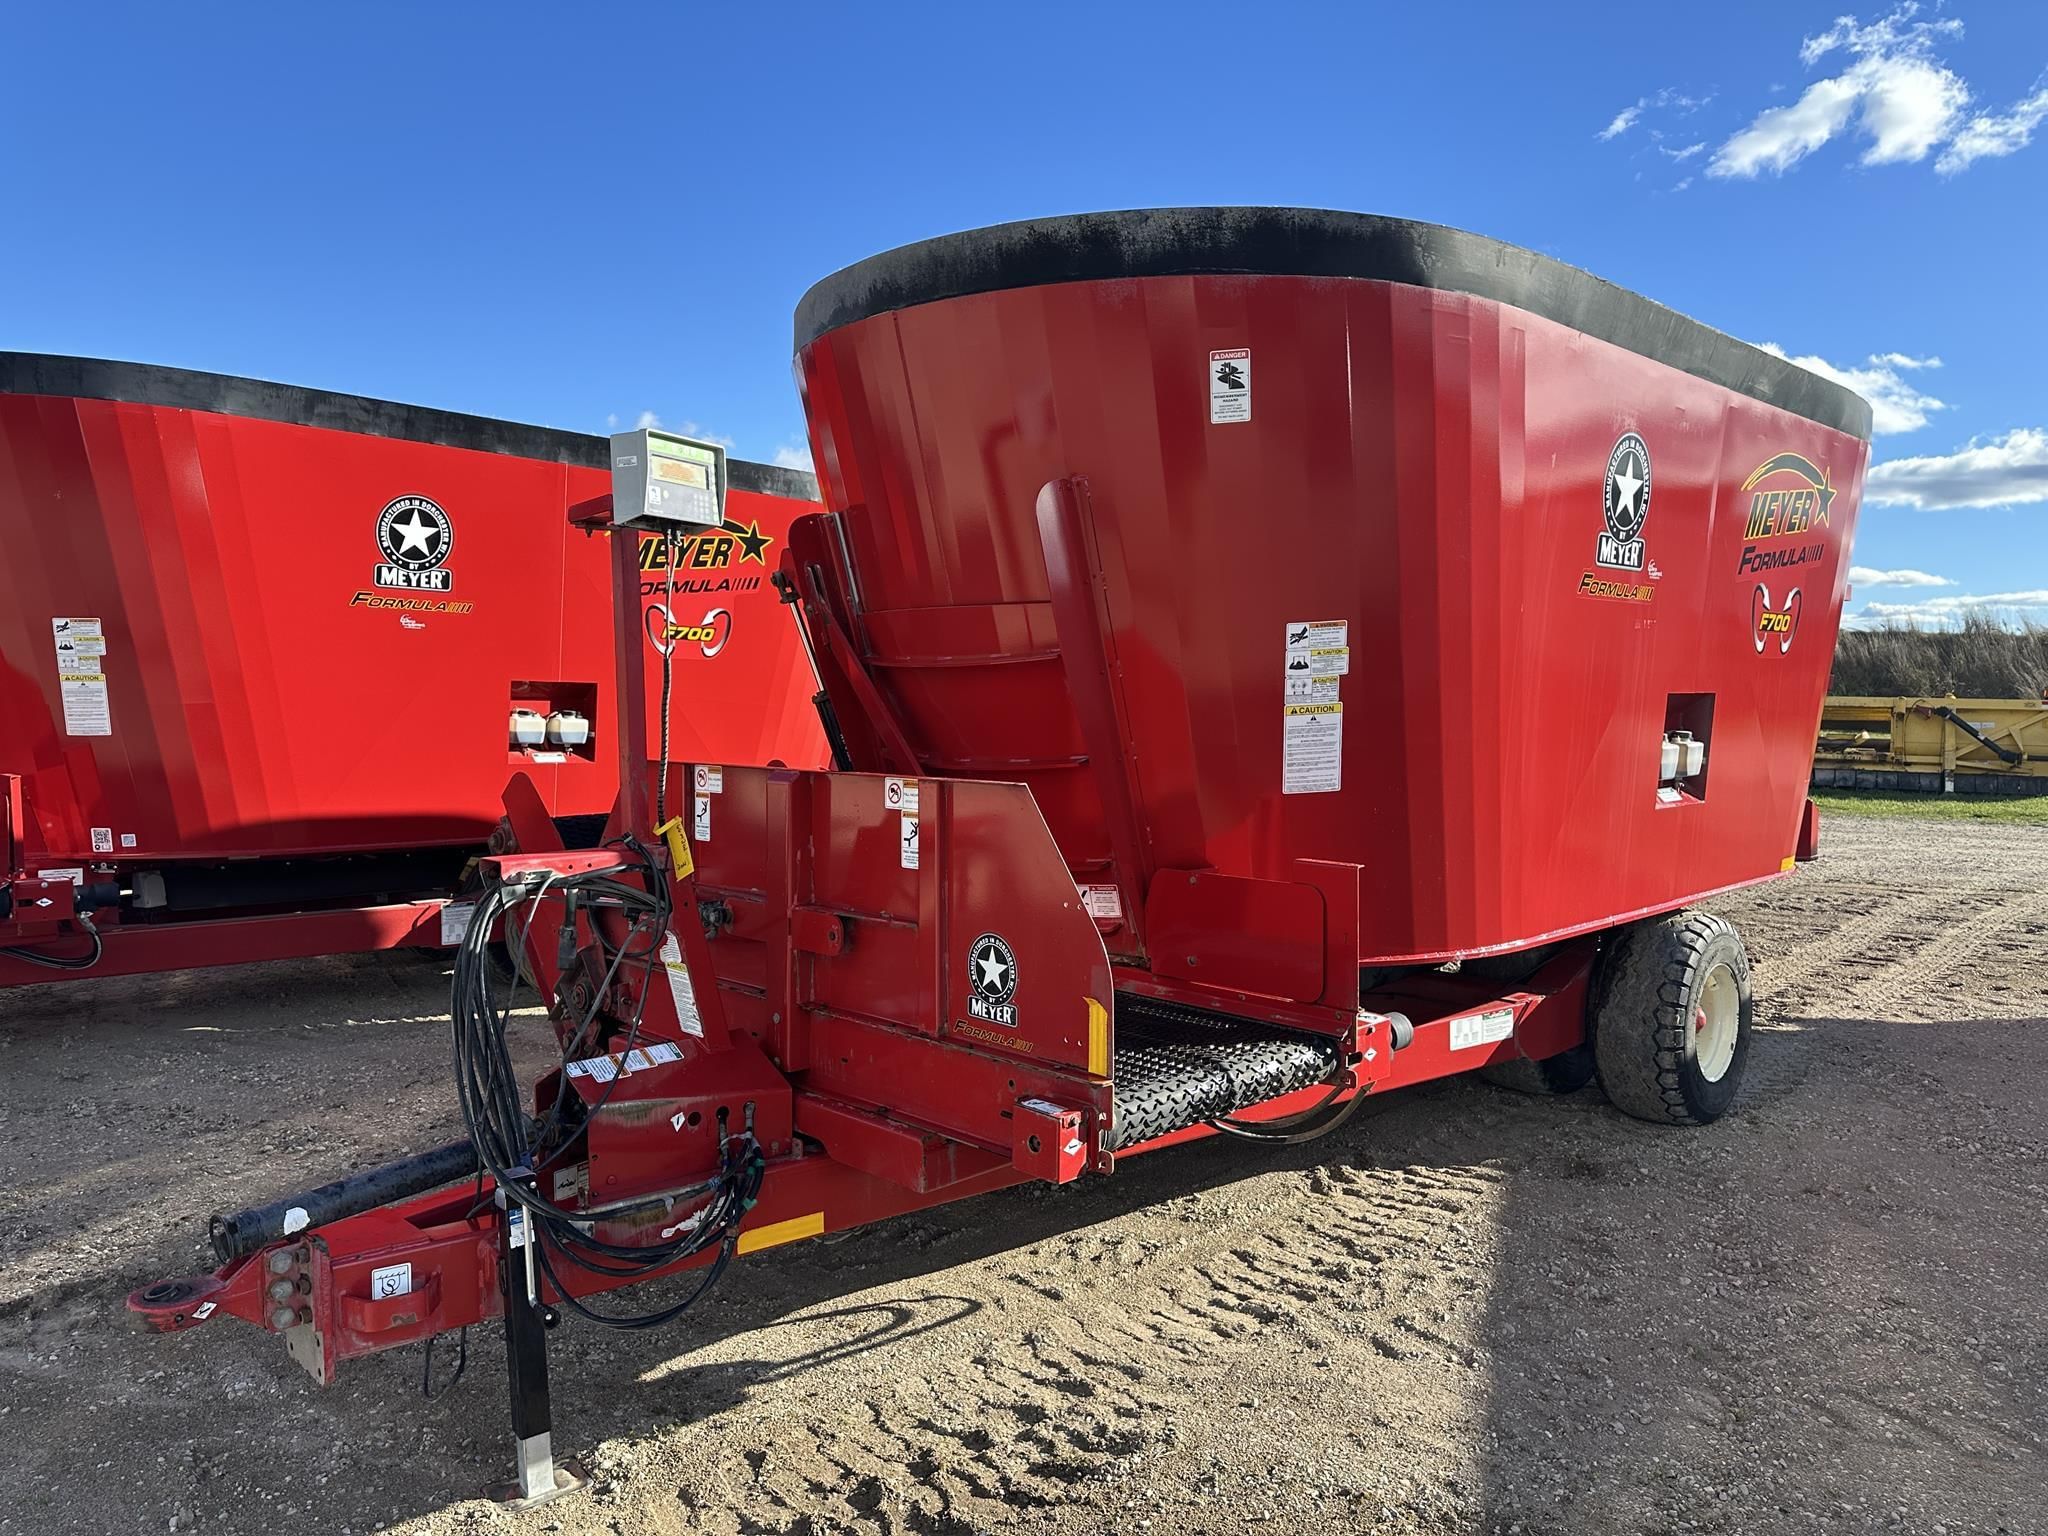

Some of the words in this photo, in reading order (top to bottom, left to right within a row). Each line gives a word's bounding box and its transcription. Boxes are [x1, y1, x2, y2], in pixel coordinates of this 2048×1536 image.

[1220, 351, 1246, 359] DANGER
[1605, 439, 1629, 508] MANUFACTURED
[1630, 439, 1635, 448] IN
[1636, 441, 1650, 501] DORCHESTER
[1743, 488, 1815, 540] MEYER
[380, 499, 411, 548] MANUFACTURED
[421, 500, 450, 541] DORCHESTER
[440, 541, 448, 553] WI
[1619, 530, 1626, 540] BY
[1599, 536, 1640, 566] MEYER
[409, 562, 419, 570] BY
[380, 566, 444, 589] MEYER
[640, 580, 731, 596] ORMULA
[1759, 611, 1791, 632] F700
[661, 625, 716, 641] F700
[1298, 705, 1335, 714] CAUTION
[970, 938, 989, 980] MANUFACTURED
[996, 939, 1015, 979] DORCHESTER
[971, 998, 1012, 1024] MEYER
